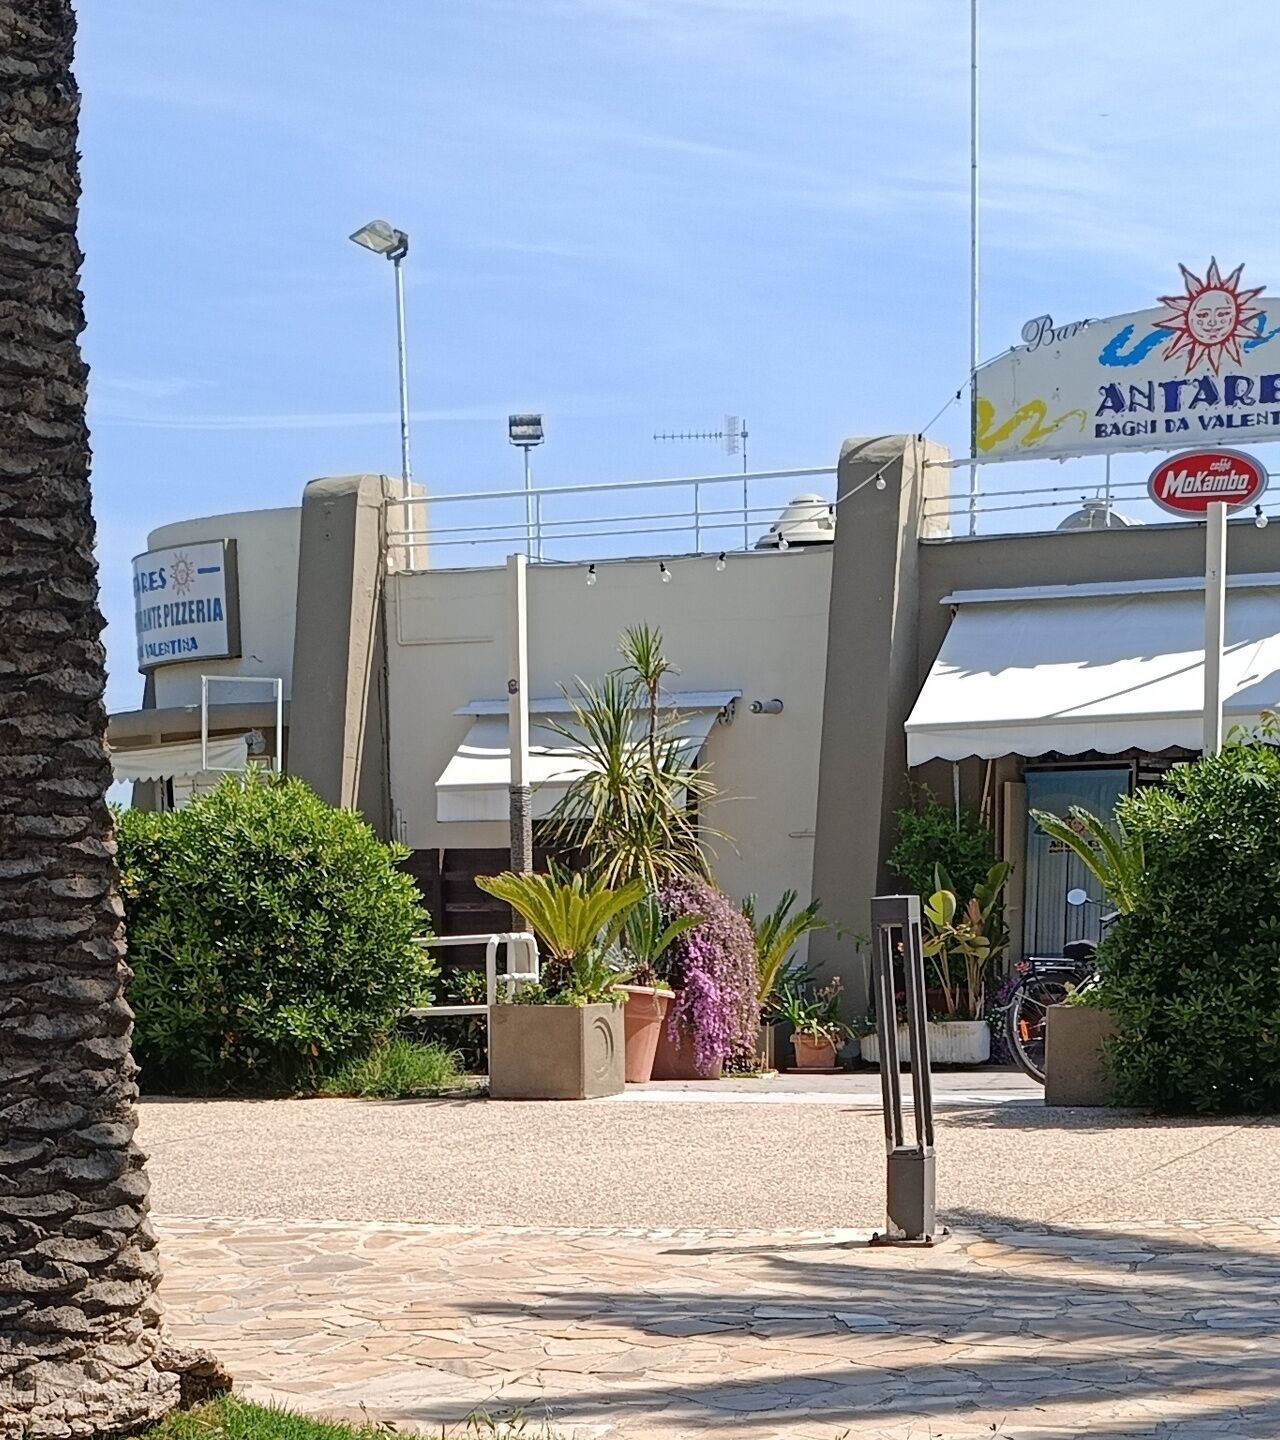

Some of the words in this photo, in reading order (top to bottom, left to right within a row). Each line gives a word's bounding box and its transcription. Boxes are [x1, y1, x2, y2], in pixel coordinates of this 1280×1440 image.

[1021, 314, 1081, 352] Bar
[1095, 419, 1157, 438] BAGNI
[1164, 417, 1190, 433] DA
[163, 598, 223, 627] PIZZERIA
[145, 636, 198, 659] VALENTINA
